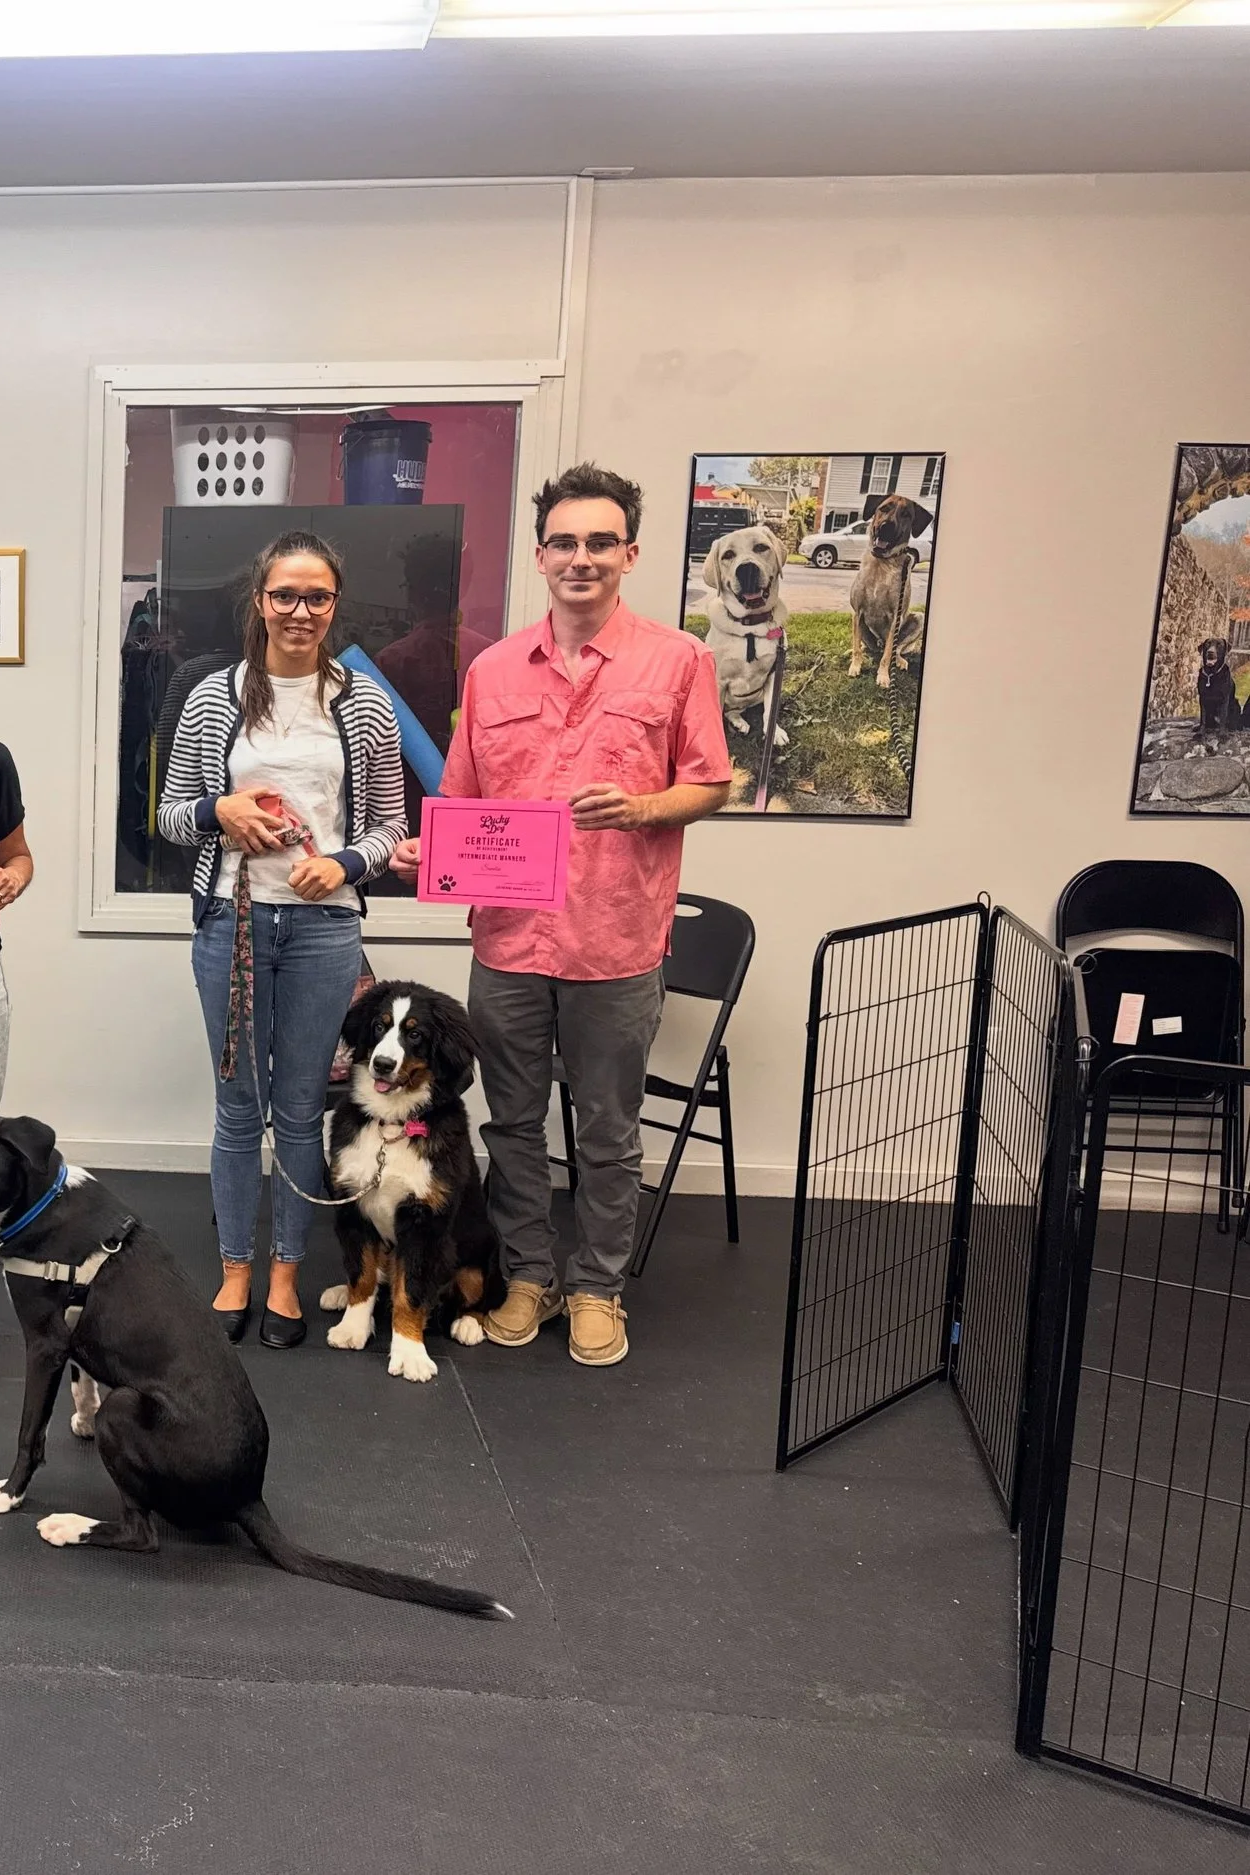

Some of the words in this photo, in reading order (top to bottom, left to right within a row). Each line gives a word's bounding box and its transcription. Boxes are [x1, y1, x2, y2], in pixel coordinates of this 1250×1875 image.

[480, 814, 510, 829] Lucky
[486, 824, 505, 834] Dog
[465, 836, 520, 847] CERTIFICATE
[458, 853, 497, 861] INTERMEDIATE
